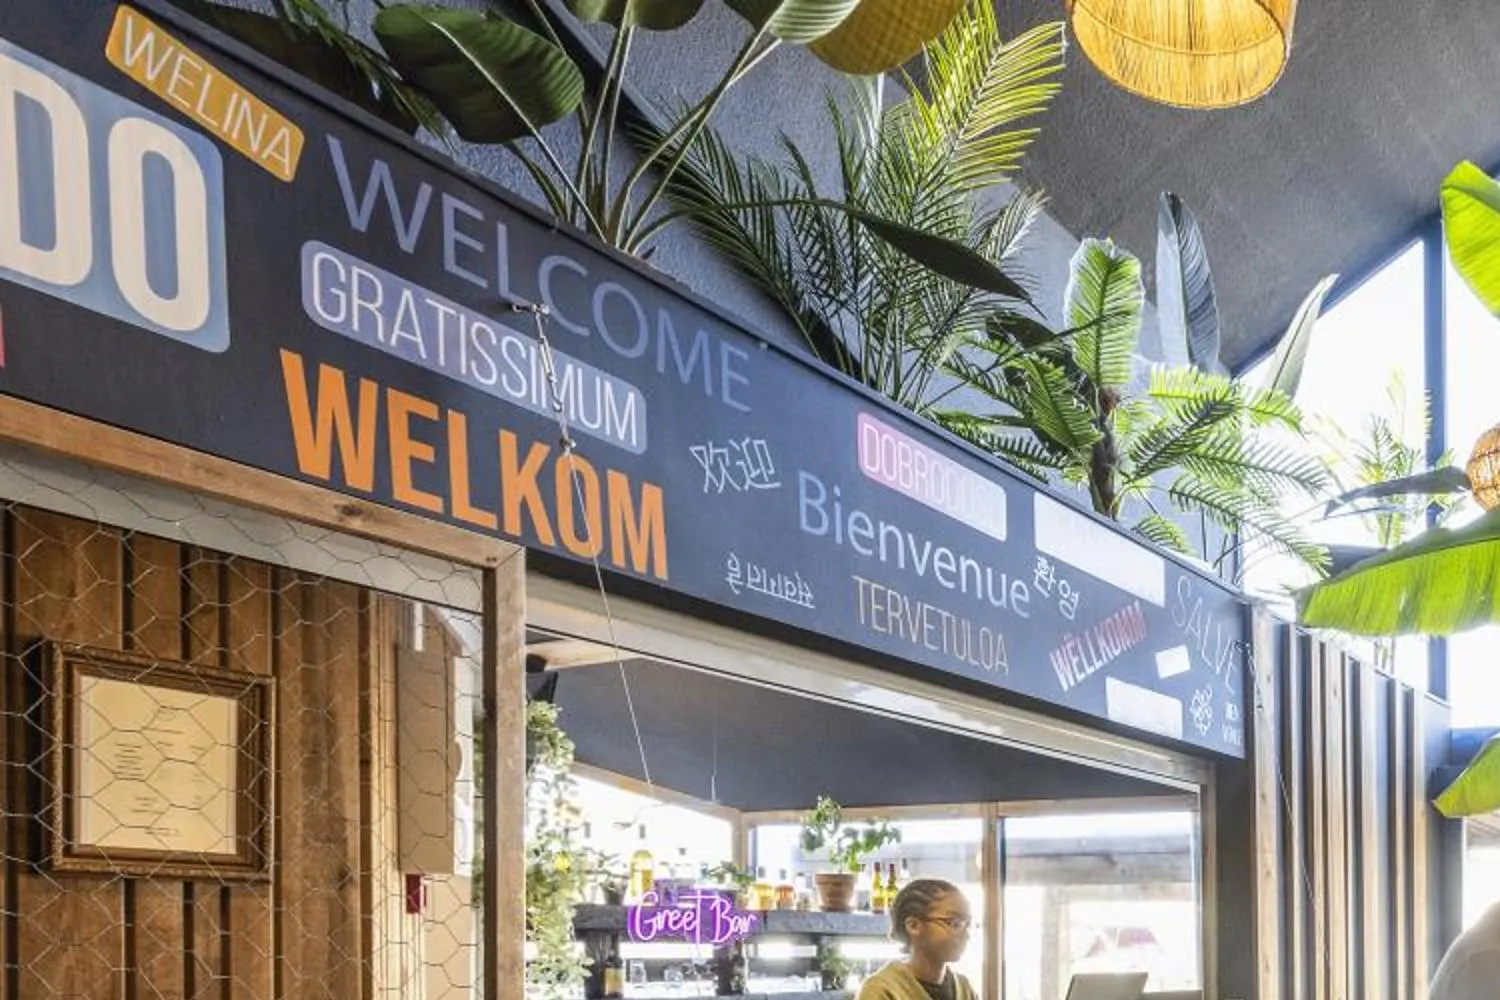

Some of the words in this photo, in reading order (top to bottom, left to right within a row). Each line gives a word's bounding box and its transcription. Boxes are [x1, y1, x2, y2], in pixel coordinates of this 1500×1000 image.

[121, 15, 294, 175] WELINA
[311, 250, 639, 447] GRATISSIMUM
[325, 132, 752, 414] WELCOME
[279, 347, 670, 581] WELKOM
[689, 435, 783, 494] 欢迎
[798, 469, 1031, 619] Bienvenue
[851, 575, 1010, 677] TERVETULOA
[634, 888, 721, 948] Greet
[709, 897, 758, 944] Bar
